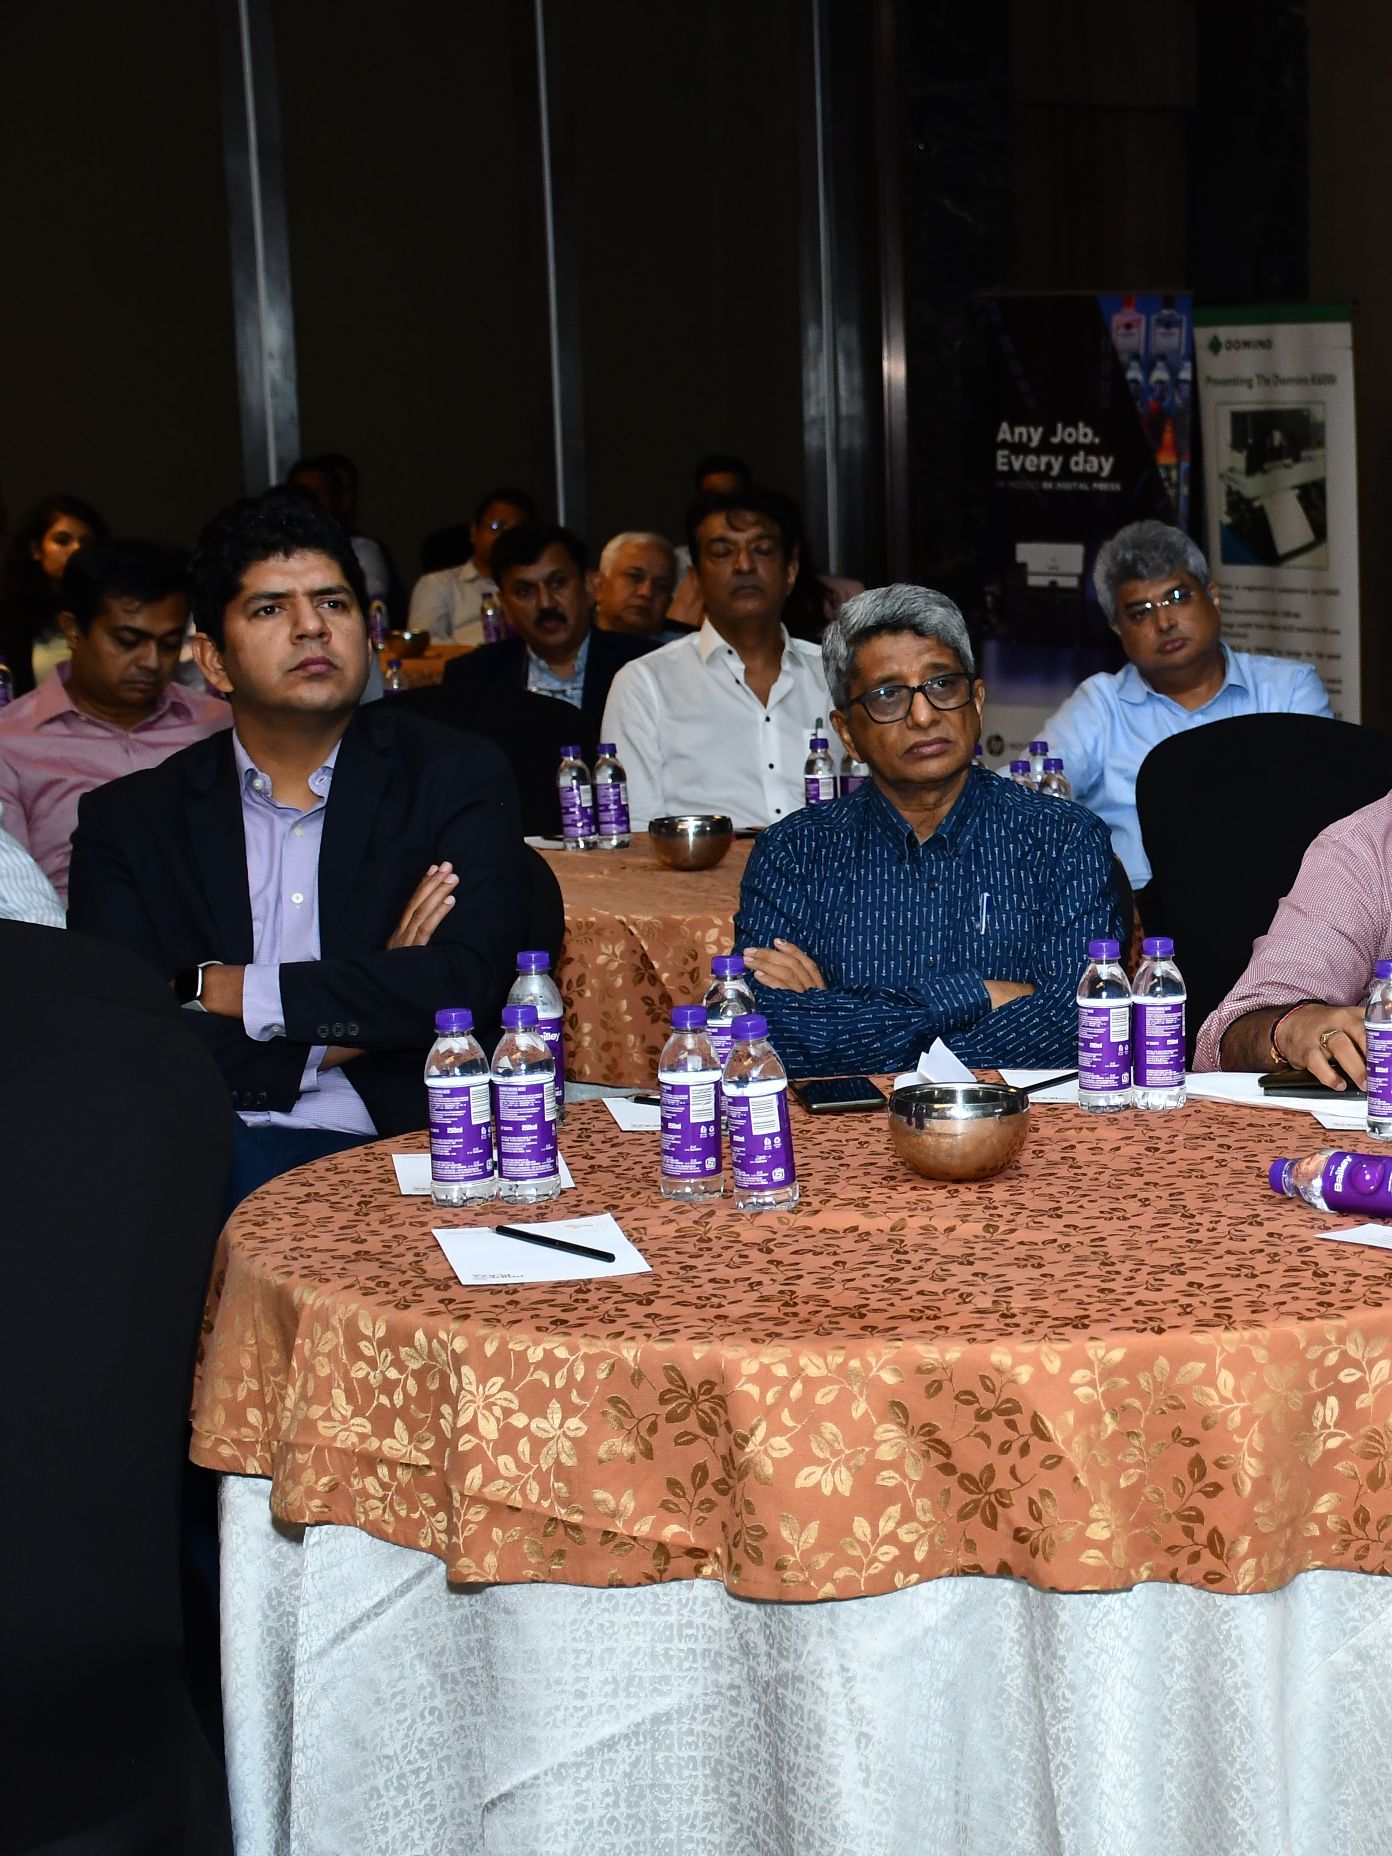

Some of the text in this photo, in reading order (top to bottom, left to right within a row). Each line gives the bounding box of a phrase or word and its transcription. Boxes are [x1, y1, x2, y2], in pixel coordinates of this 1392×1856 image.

[995, 419, 1100, 448] Any Job.
[995, 450, 1116, 478] Every day
